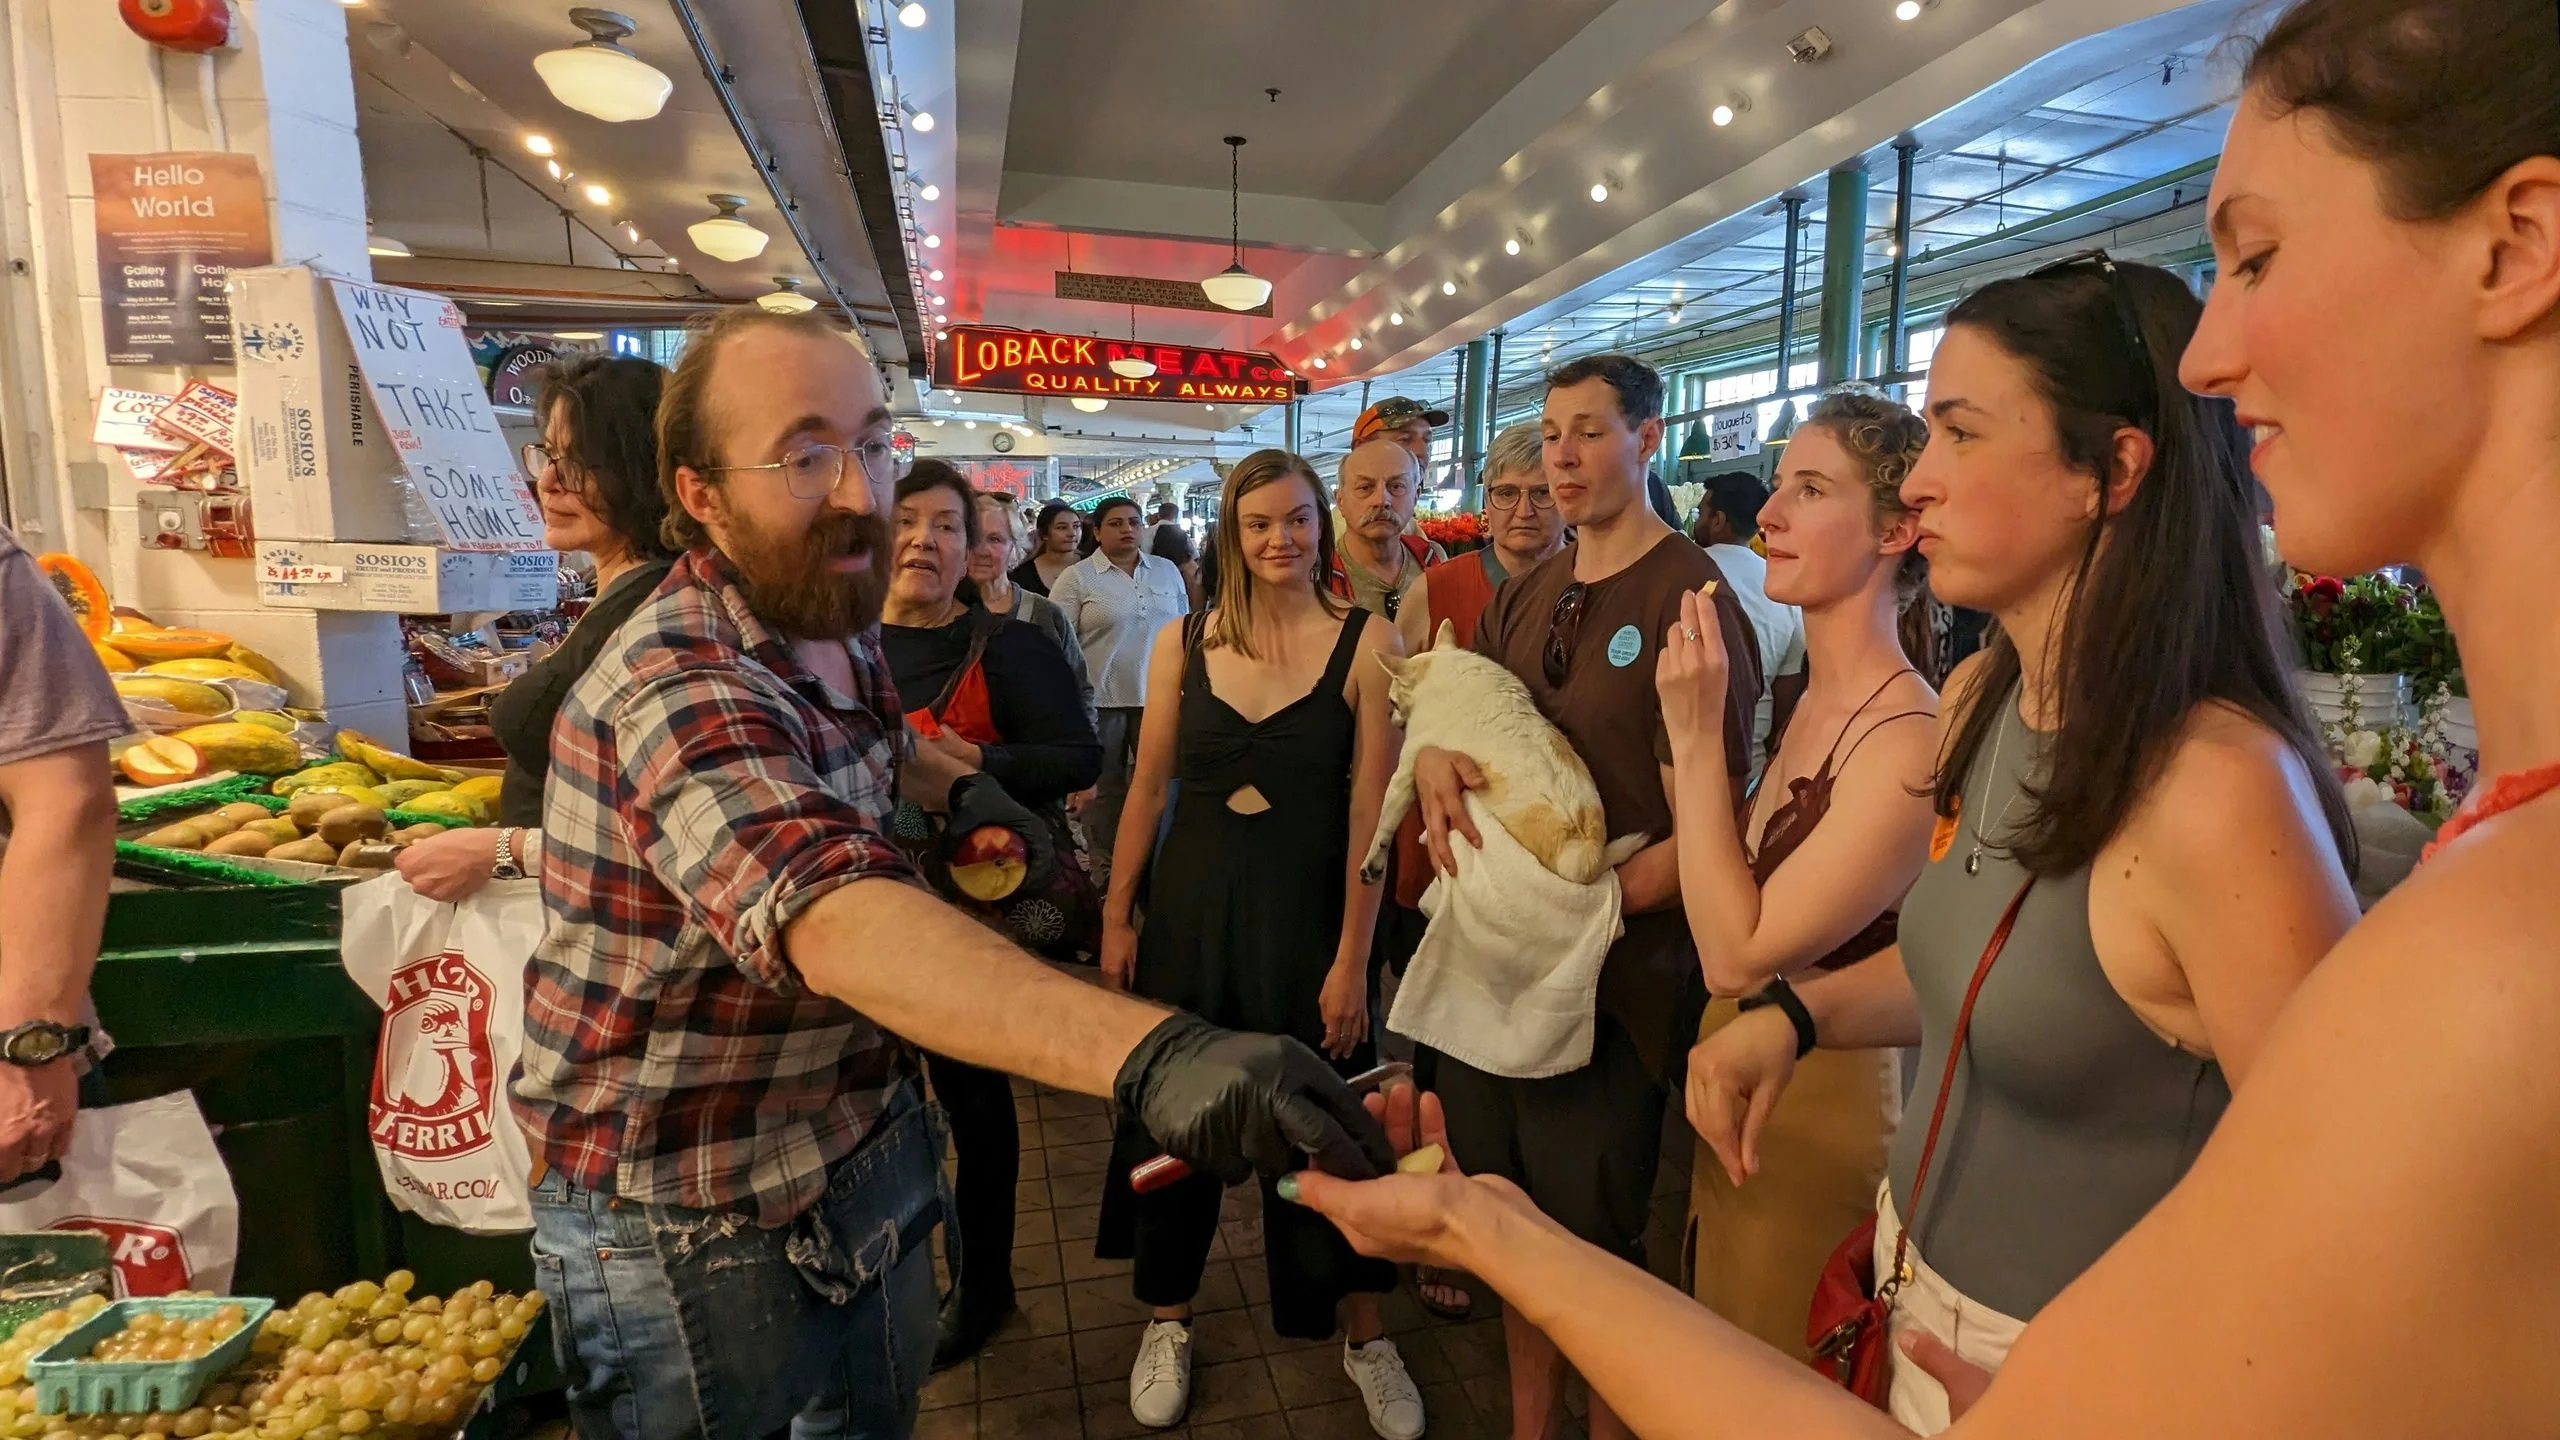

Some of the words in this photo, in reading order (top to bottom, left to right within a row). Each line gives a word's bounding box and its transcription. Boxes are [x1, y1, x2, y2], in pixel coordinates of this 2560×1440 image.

[134, 165, 204, 186] Hello
[132, 196, 215, 218] World
[124, 265, 166, 276] Gallery
[127, 278, 166, 288] Events
[1062, 274, 1085, 282] THIS
[1145, 281, 1180, 289] PUBLIC
[350, 286, 412, 319] WHY
[355, 313, 427, 352] NOT
[956, 333, 1095, 383] LOBACK
[1106, 343, 1248, 379] MEAT
[1026, 373, 1161, 394] QUALITY
[1180, 383, 1288, 399] ALWAYS
[348, 364, 363, 447] PERISHABLE
[377, 383, 491, 433] TAKE
[297, 408, 316, 477] SOSIO'S
[424, 465, 513, 502] SOME
[440, 503, 533, 540] HOME
[355, 553, 427, 568] SOSIO'S
[510, 555, 554, 566] SOSIO'S
